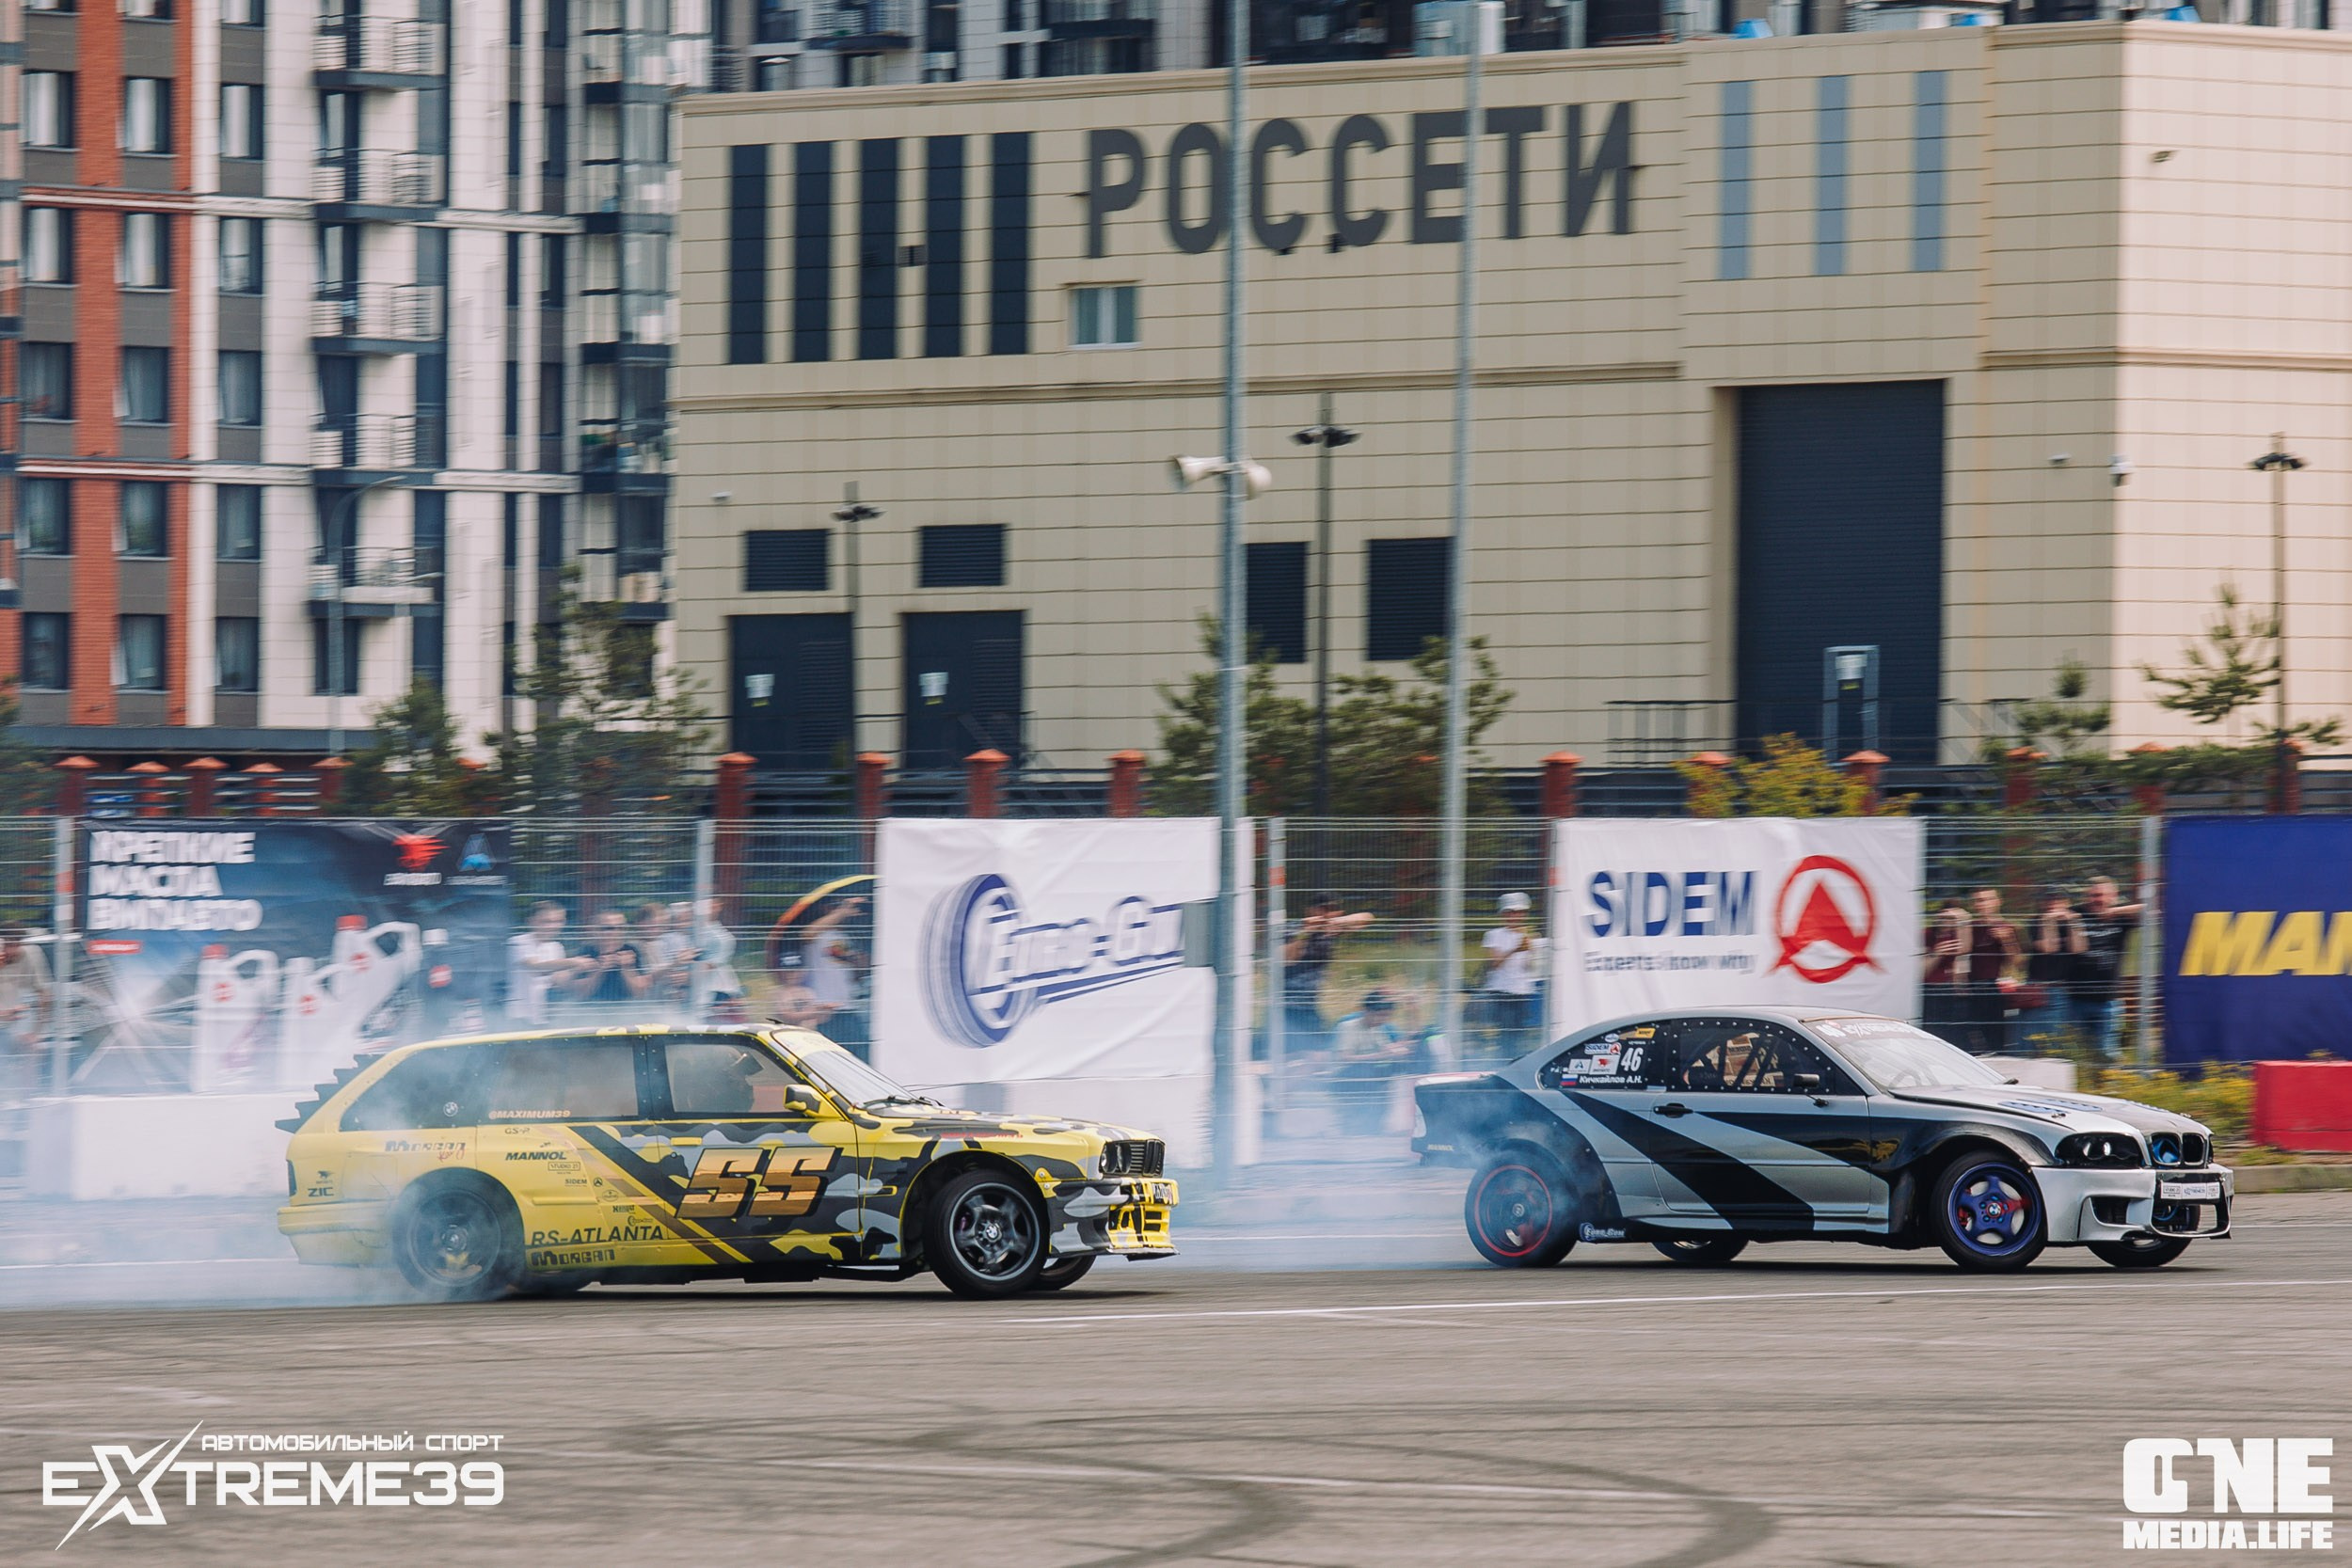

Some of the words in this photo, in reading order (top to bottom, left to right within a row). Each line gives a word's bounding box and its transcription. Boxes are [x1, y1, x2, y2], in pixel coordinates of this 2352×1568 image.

[1087, 100, 1635, 260] РОССЕТИ
[1584, 871, 1759, 937] SIDEM
[1621, 1048, 1644, 1072] 46
[488, 1110, 570, 1120] @MAXIMUM39
[505, 1151, 567, 1161] MANNOL
[308, 1187, 334, 1196] ZIC
[531, 1226, 664, 1245] RS-ATLANTA
